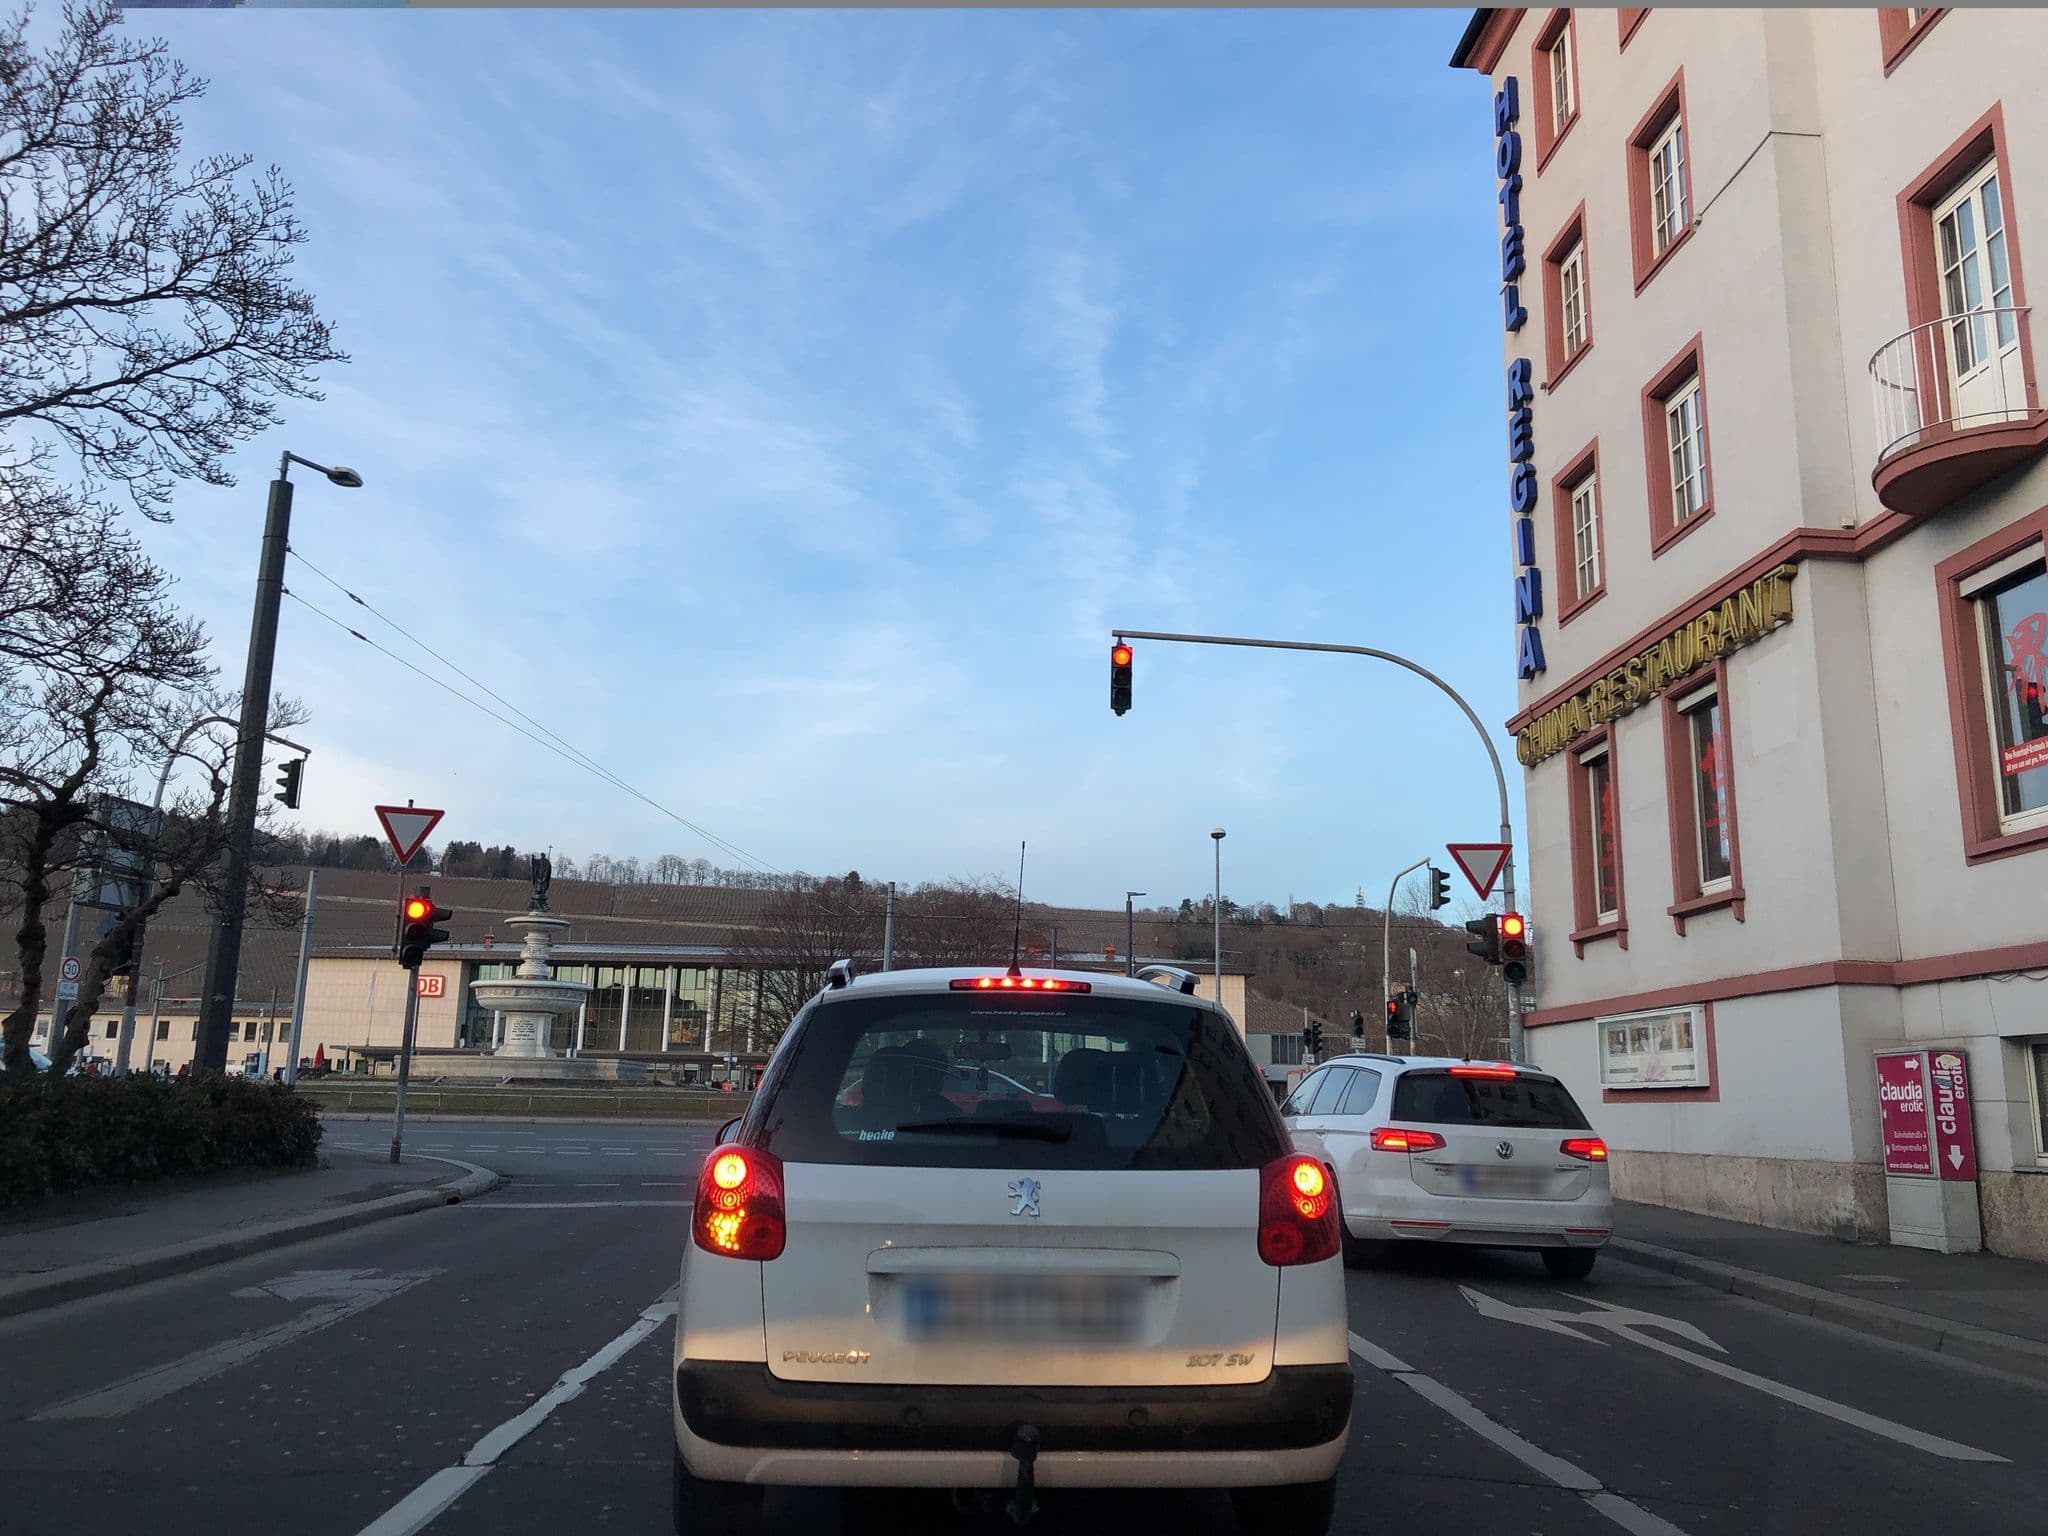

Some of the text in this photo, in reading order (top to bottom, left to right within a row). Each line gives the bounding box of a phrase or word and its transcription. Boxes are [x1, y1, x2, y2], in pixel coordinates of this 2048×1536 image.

[1494, 76, 1547, 681] HOTEL REGINA
[1516, 564, 1798, 767] CHINA-RESTAURANT
[66, 963, 78, 976] 30
[417, 978, 439, 993] DB
[1950, 1057, 1965, 1100] eroti
[1880, 1080, 1923, 1101] claudia
[1900, 1100, 1924, 1113] erotic
[859, 1129, 895, 1141] henke
[782, 1350, 871, 1365] PEUGEOT
[1224, 1352, 1255, 1367] SW
